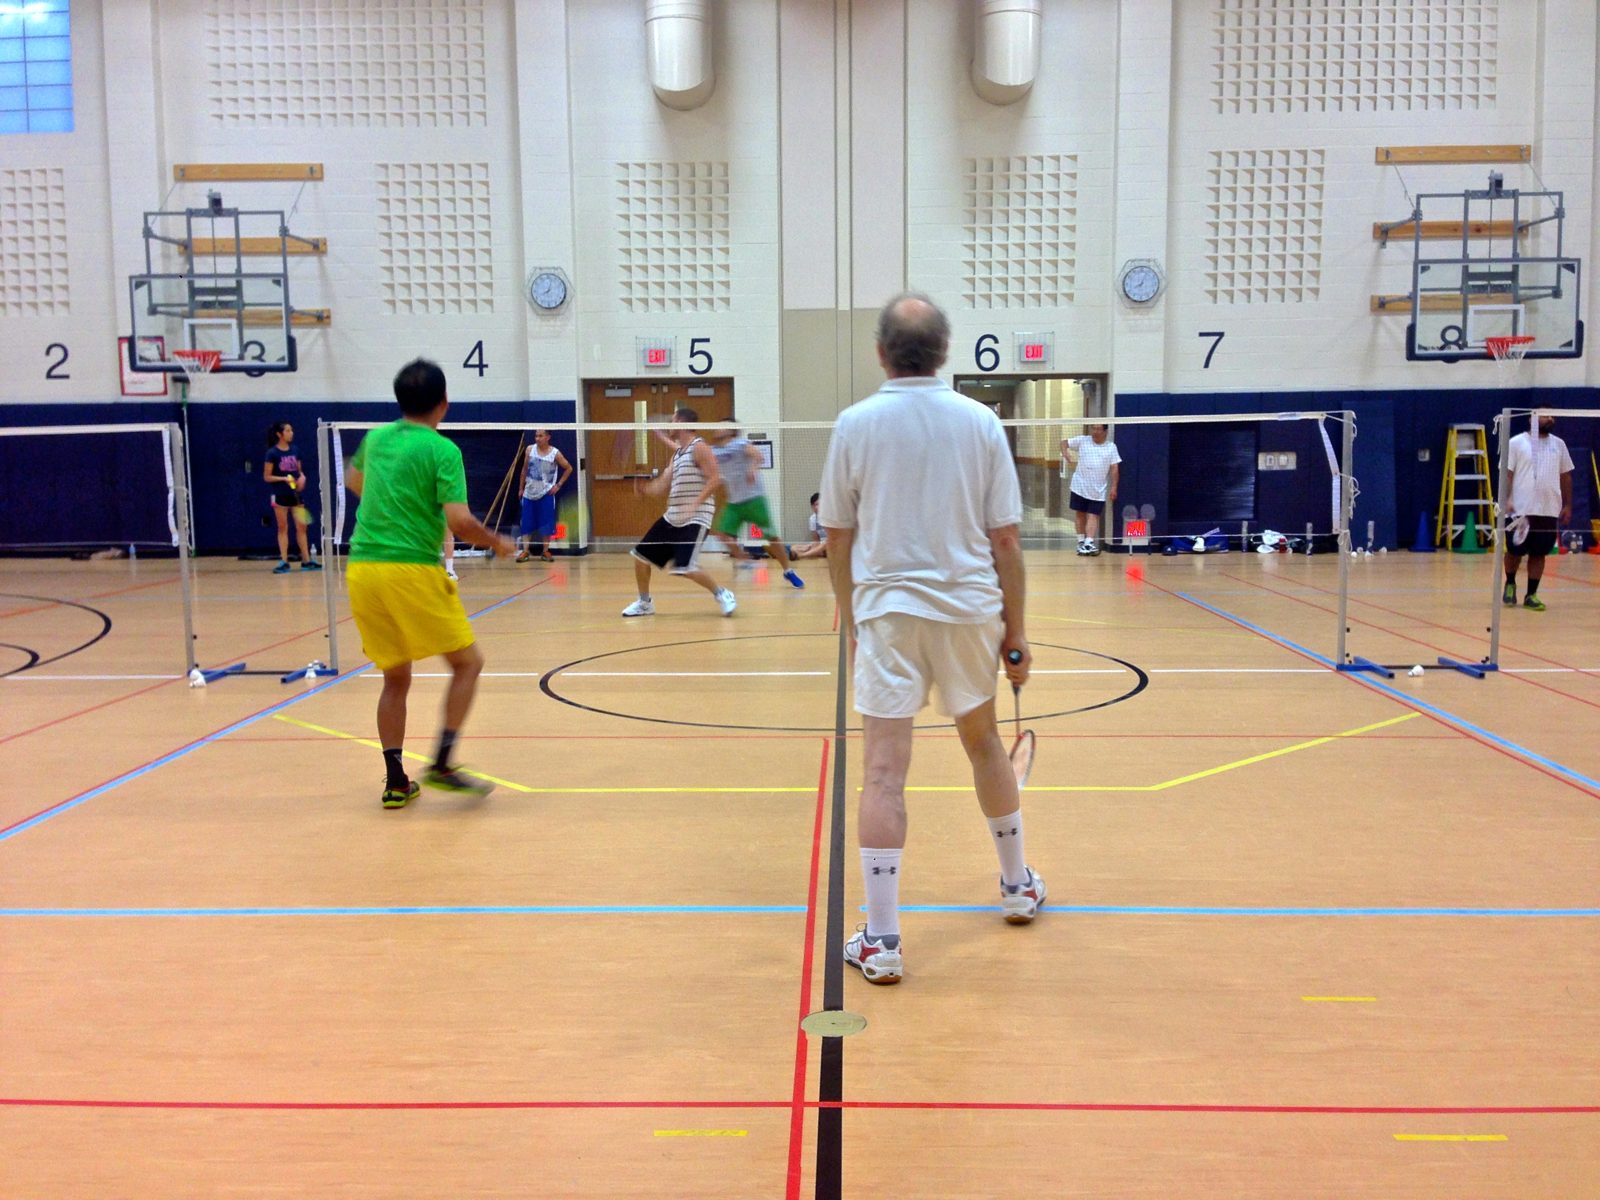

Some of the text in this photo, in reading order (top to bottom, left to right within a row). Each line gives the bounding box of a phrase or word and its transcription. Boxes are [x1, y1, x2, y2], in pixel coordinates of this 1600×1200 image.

[46, 344, 69, 379] 2
[243, 341, 266, 377] 3
[463, 341, 488, 376] 4
[648, 349, 666, 364] EXIT
[688, 338, 713, 375] 5
[975, 334, 1000, 372] 6
[1025, 344, 1044, 359] EXIT
[1199, 332, 1224, 368] 7
[1440, 325, 1464, 363] 8
